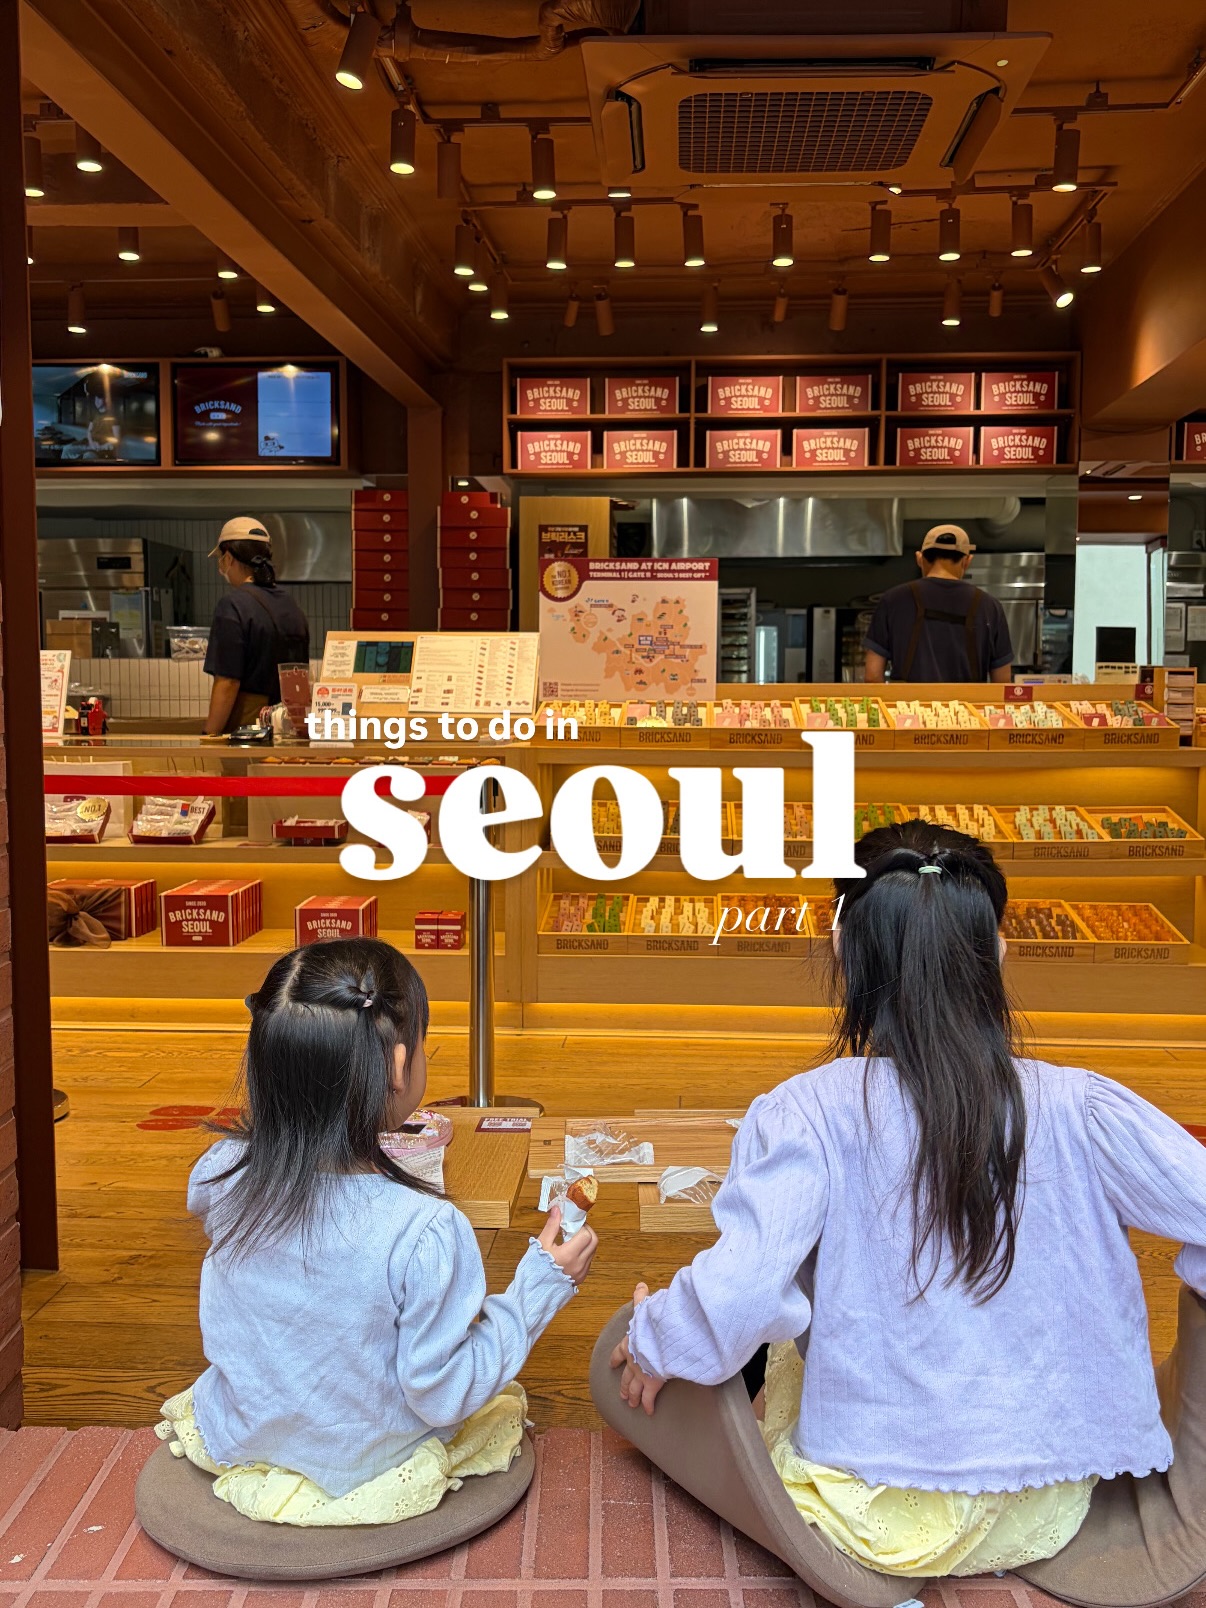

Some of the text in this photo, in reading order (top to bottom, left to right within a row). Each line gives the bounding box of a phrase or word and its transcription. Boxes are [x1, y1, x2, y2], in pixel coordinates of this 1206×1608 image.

[526, 386, 580, 400] BRICKSAND
[615, 386, 669, 400] BRICKSAND
[718, 385, 772, 399] BRICKSAND
[806, 384, 862, 398] BRICKSAND
[908, 382, 964, 396] BRICKSAND
[992, 380, 1048, 395] BRICKSAND
[540, 398, 568, 410] SEOUL
[628, 398, 657, 410] SEOUL
[730, 397, 760, 409] SEOUL
[819, 396, 849, 408] SEOUL
[922, 394, 952, 406] SEOUL
[1004, 393, 1035, 405] SEOUL
[194, 400, 242, 414] BRICKSAND
[527, 440, 581, 454] BRICKSAND
[612, 439, 667, 454] BRICKSAND
[716, 438, 771, 452] BRICKSAND
[802, 437, 858, 451] BRICKSAND
[907, 436, 963, 450] BRICKSAND
[990, 435, 1047, 450] BRICKSAND
[540, 452, 570, 464] SEOUL
[626, 451, 656, 463] SEOUL
[728, 450, 758, 462] SEOUL
[816, 449, 846, 461] SEOUL
[920, 448, 950, 460] SEOUL
[1004, 447, 1034, 459] SEOUL
[638, 731, 691, 743] BRICKSAND
[729, 733, 782, 744] BRICKSAND
[914, 733, 968, 745] BRICKSAND
[1009, 733, 1064, 744] BRICKSAND
[1104, 732, 1159, 744] BRICKSAND
[190, 806, 206, 815] BEST
[1033, 847, 1089, 858] BRICKSAND
[1128, 845, 1184, 857] BRICKSAND
[168, 909, 225, 922] BRICKSAND
[182, 921, 212, 932] SEOUL
[306, 919, 353, 930] BRICKSAND
[317, 928, 341, 938] SEOUL
[556, 939, 608, 950] BRICKSAND
[646, 940, 699, 951] BRICKSAND
[737, 941, 790, 952] BRICKSAND
[1019, 946, 1074, 958] BRICKSAND
[1114, 948, 1170, 959] BRICKSAND
